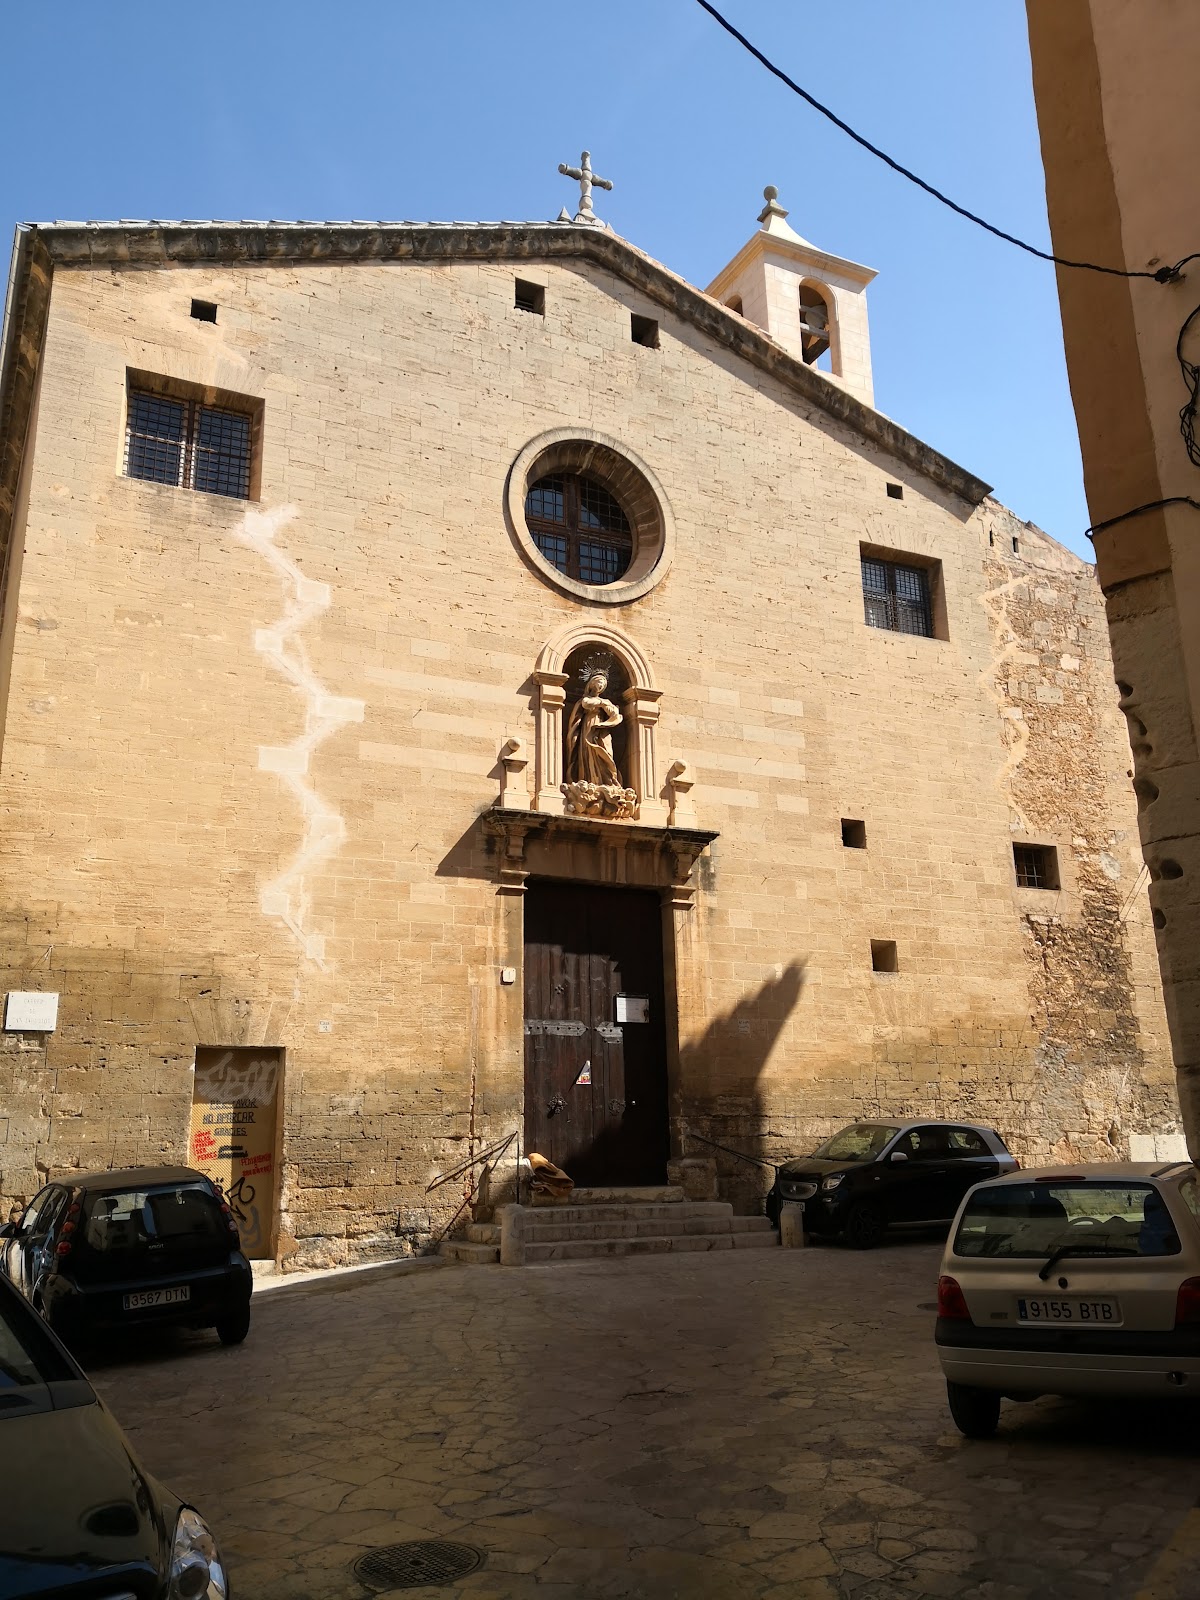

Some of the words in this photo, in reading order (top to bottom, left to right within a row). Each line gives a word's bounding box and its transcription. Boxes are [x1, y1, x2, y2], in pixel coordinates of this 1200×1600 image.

[203, 1114, 214, 1124] NO
[216, 1111, 255, 1123] APARCAR
[131, 1291, 162, 1307] 3567
[165, 1287, 188, 1302] DTN
[1030, 1301, 1072, 1319] 9155
[1080, 1302, 1113, 1320] BTB
